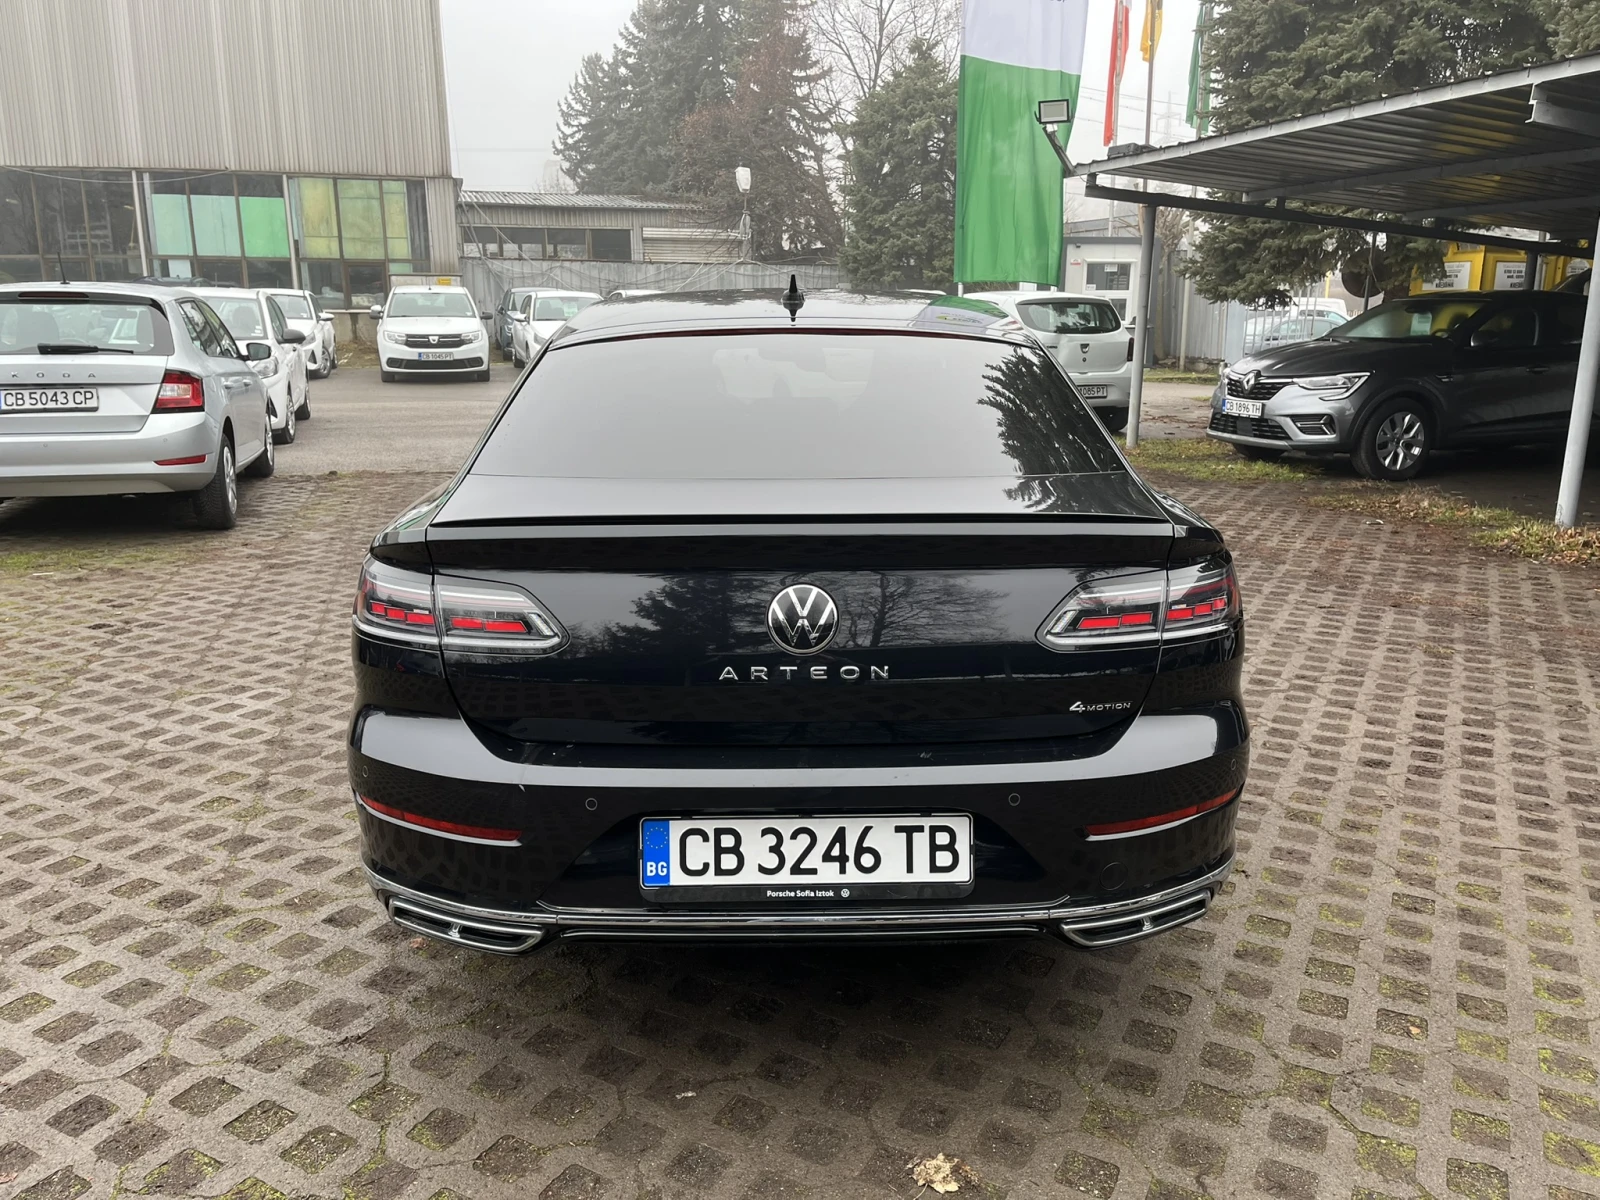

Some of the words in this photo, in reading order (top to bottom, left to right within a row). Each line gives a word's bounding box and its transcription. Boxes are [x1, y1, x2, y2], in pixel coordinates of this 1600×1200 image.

[10, 371, 97, 379] KODA
[3, 391, 26, 407] CB
[28, 390, 70, 406] 5043
[72, 390, 94, 405] CP
[1096, 386, 1106, 396] PT
[1226, 400, 1234, 411] CB
[1235, 402, 1250, 413] 1896
[1251, 403, 1261, 415] TH
[718, 665, 890, 681] ARTEON
[1069, 701, 1131, 713] 4MOTION
[678, 827, 745, 877] CB
[757, 825, 882, 876] 3246
[893, 824, 960, 875] TB
[646, 861, 668, 876] BG
[766, 889, 796, 898] Porsche
[796, 889, 815, 898] Sofia
[815, 889, 835, 898] Iztok
